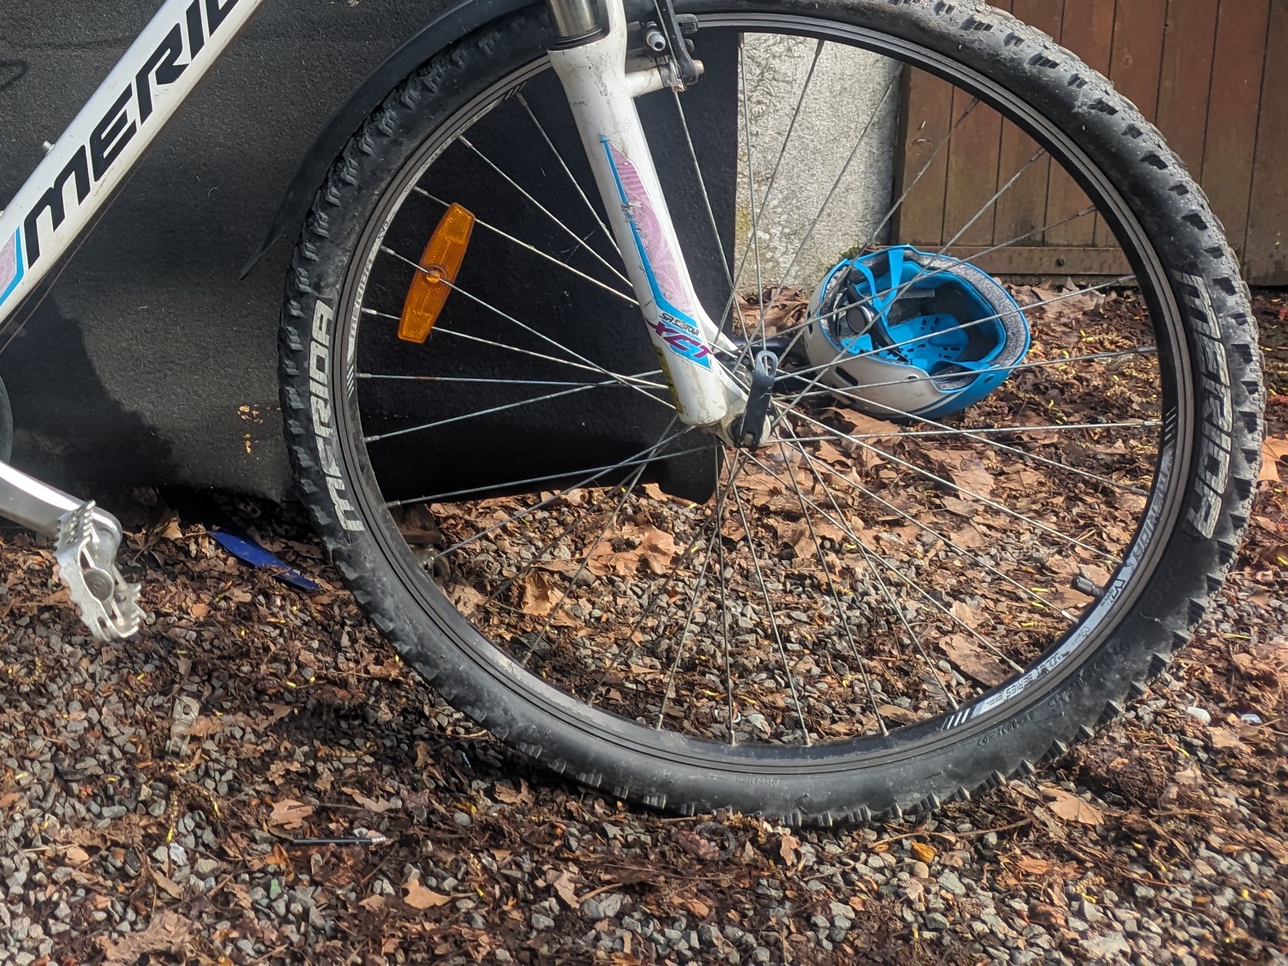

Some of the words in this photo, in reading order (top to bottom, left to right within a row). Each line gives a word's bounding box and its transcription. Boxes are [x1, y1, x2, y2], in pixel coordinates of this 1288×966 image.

[309, 299, 366, 532] MERIDA
[659, 312, 675, 323] SR
[1172, 269, 1233, 538] MERIDA
